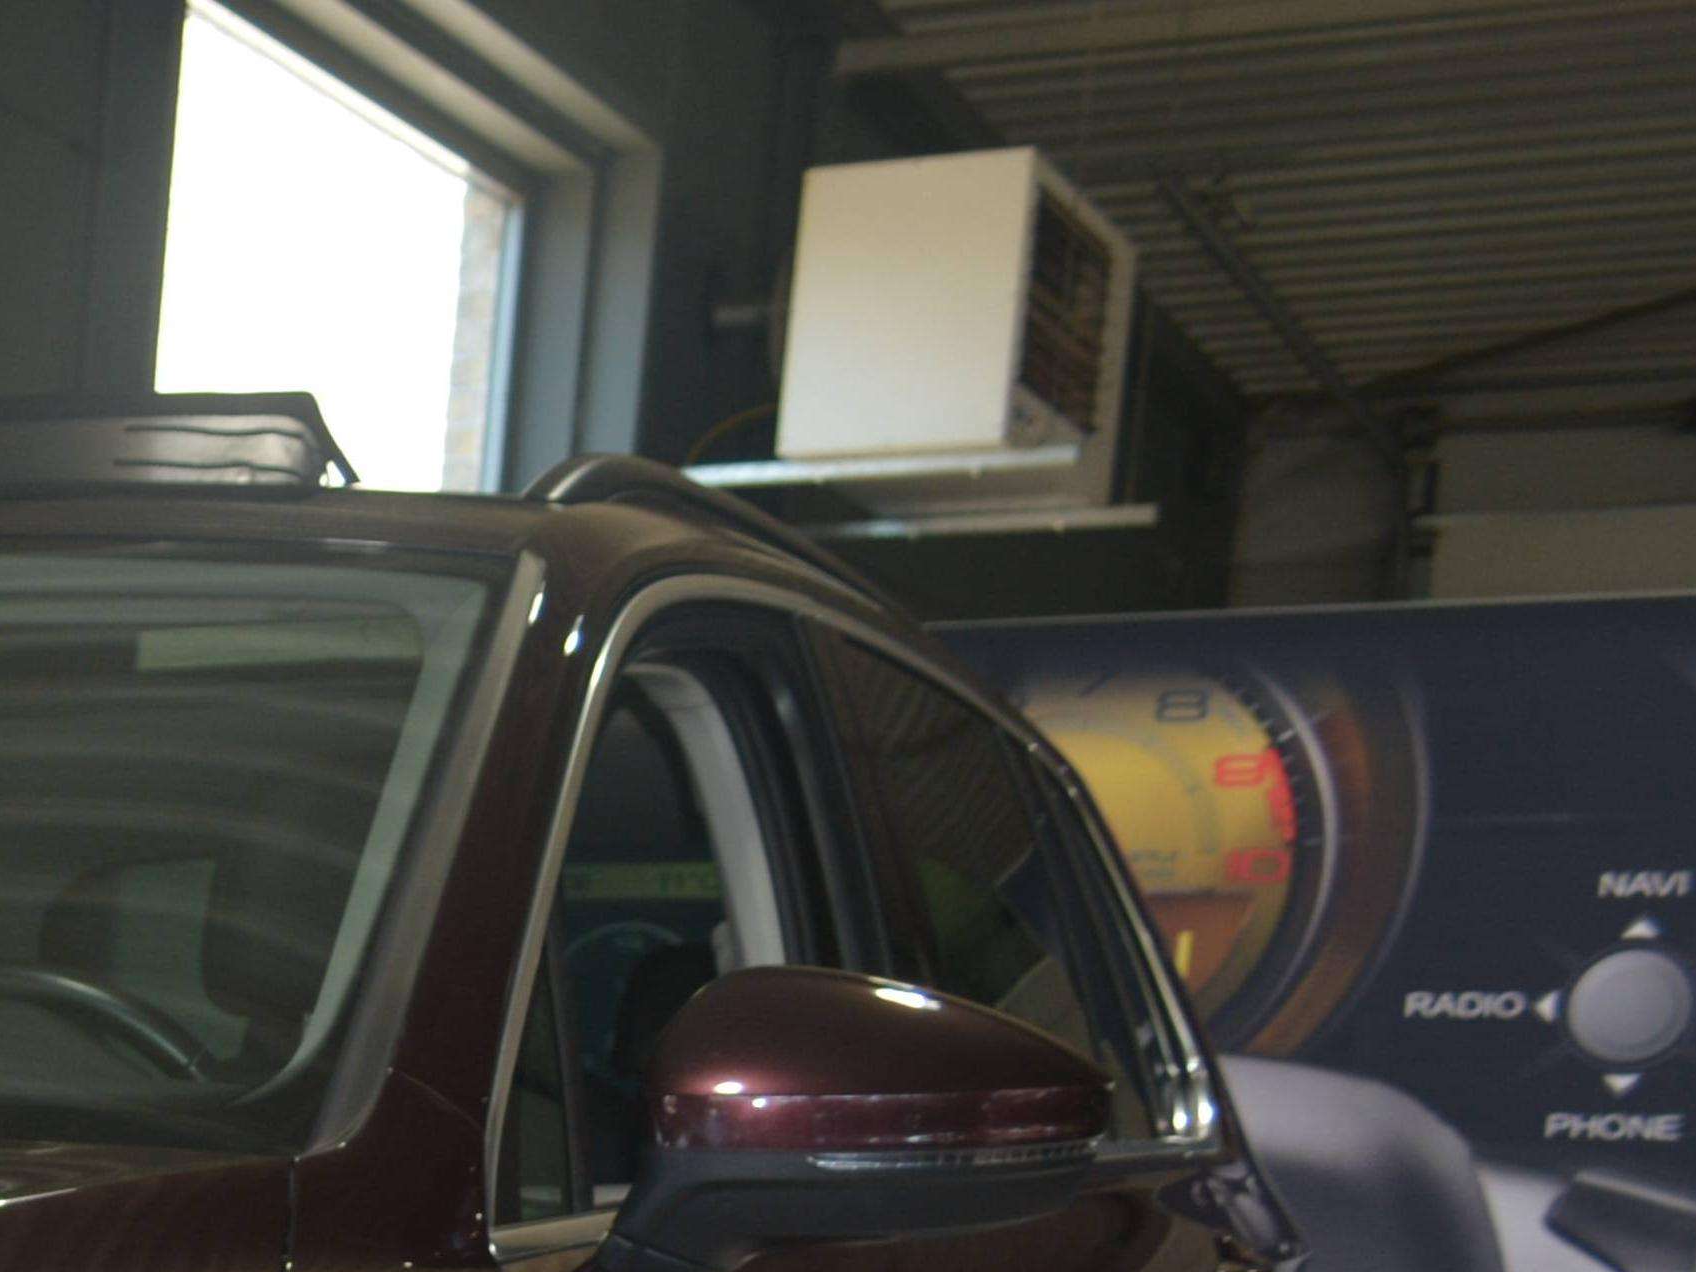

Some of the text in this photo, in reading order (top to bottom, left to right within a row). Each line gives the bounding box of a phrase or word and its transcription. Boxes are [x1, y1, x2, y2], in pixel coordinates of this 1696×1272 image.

[1597, 869, 1692, 898] NAVI
[1403, 990, 1527, 1020] RADIO
[1543, 1111, 1684, 1142] PHONE
